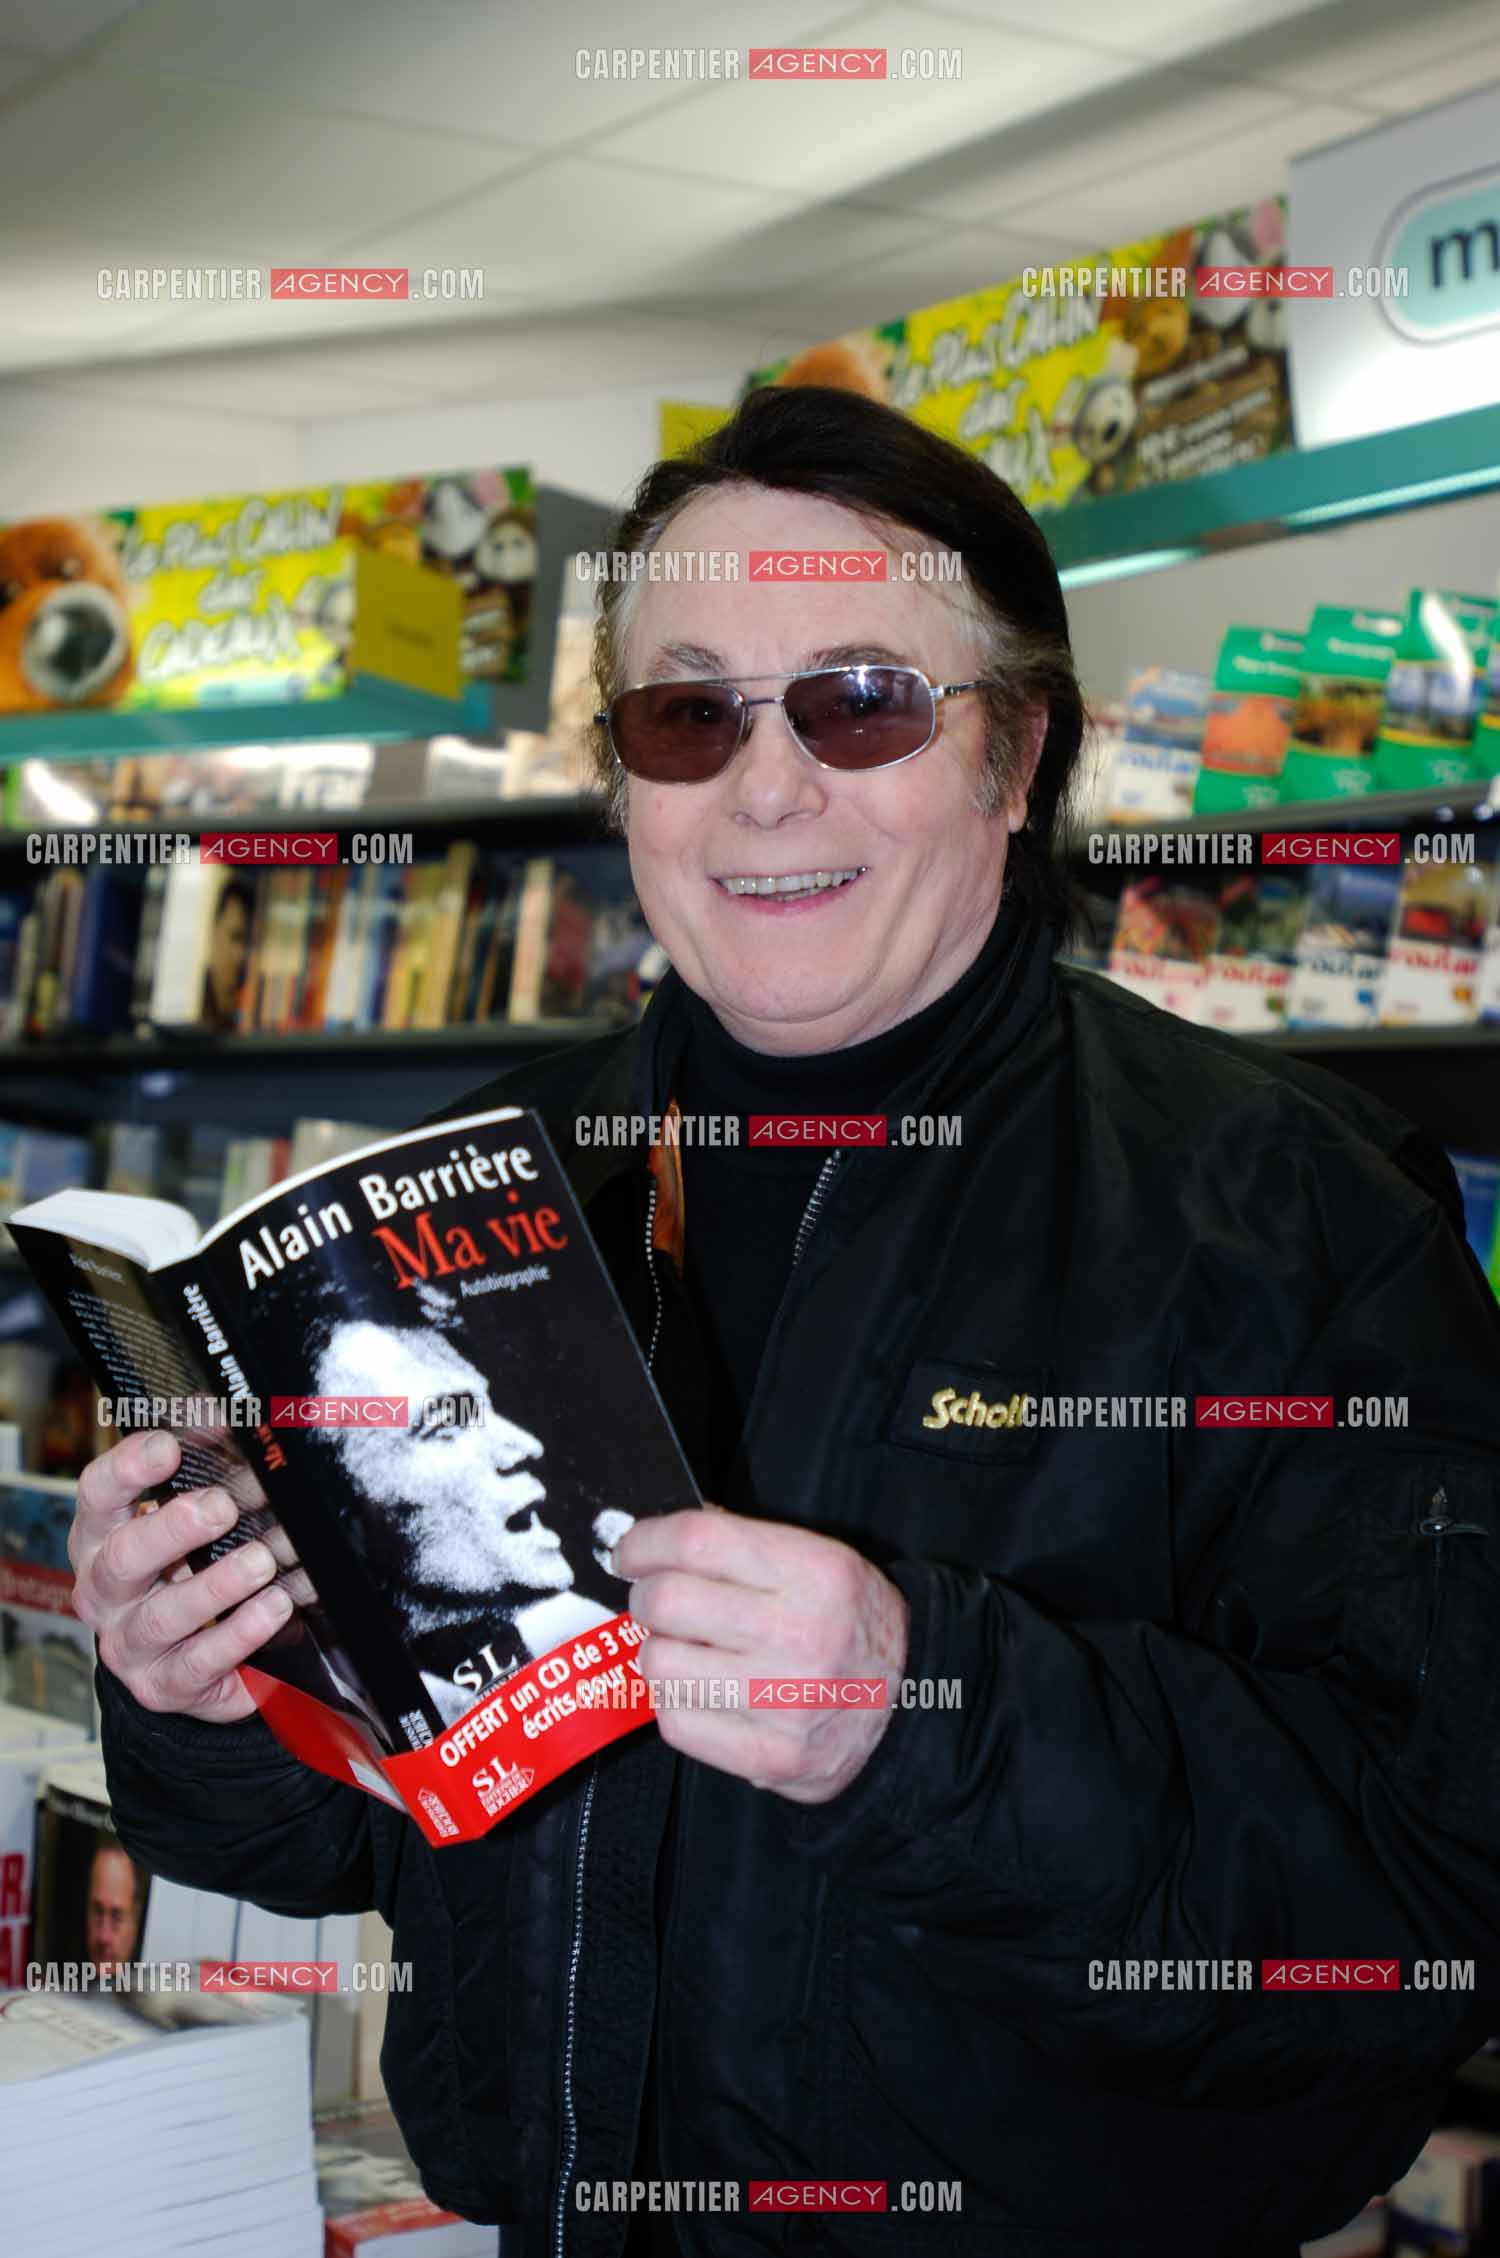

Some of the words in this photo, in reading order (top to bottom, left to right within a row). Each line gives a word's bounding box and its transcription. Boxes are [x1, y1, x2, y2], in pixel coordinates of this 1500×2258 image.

[239, 1203, 353, 1291] Alain
[359, 1144, 539, 1221] Barrière
[371, 1211, 487, 1290] Ma
[485, 1189, 569, 1258] vie
[439, 1696, 510, 1768] OFFERT
[509, 1681, 541, 1713] un
[537, 1656, 571, 1690] CD
[572, 1642, 603, 1671] de
[598, 1630, 619, 1657] 3
[522, 1691, 578, 1740] écrits
[577, 1662, 626, 1709] pour
